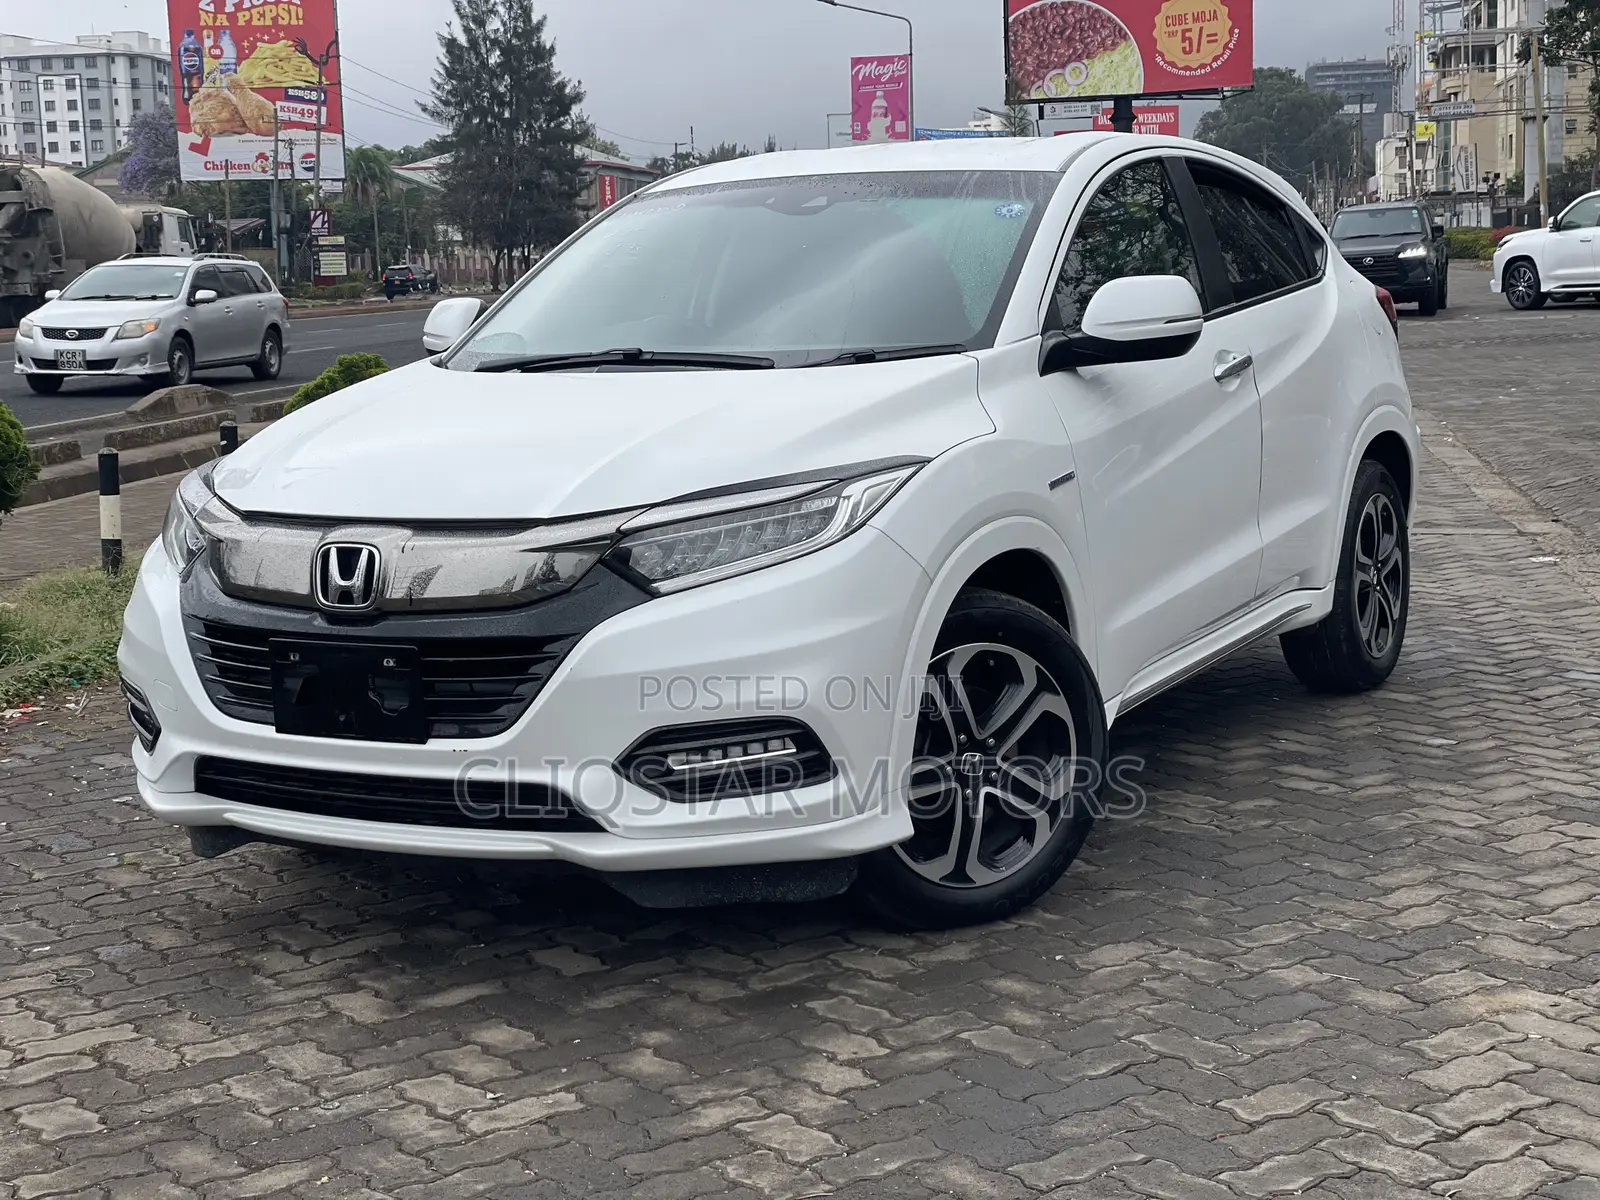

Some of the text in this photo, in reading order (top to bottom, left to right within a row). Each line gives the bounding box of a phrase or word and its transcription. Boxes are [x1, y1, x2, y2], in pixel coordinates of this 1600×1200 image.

[199, 10, 230, 26] NA
[237, 3, 304, 26] PEPSI!
[1165, 9, 1218, 28] CUBE MOJA
[1181, 26, 1218, 55] 5/=
[1211, 49, 1232, 69] Retail
[1228, 28, 1240, 49] Price
[852, 57, 907, 82] Magic
[1138, 113, 1175, 124] WEEKDAYS
[1141, 125, 1159, 134] WITH
[204, 161, 251, 171] Chiken
[60, 350, 77, 360] KCR
